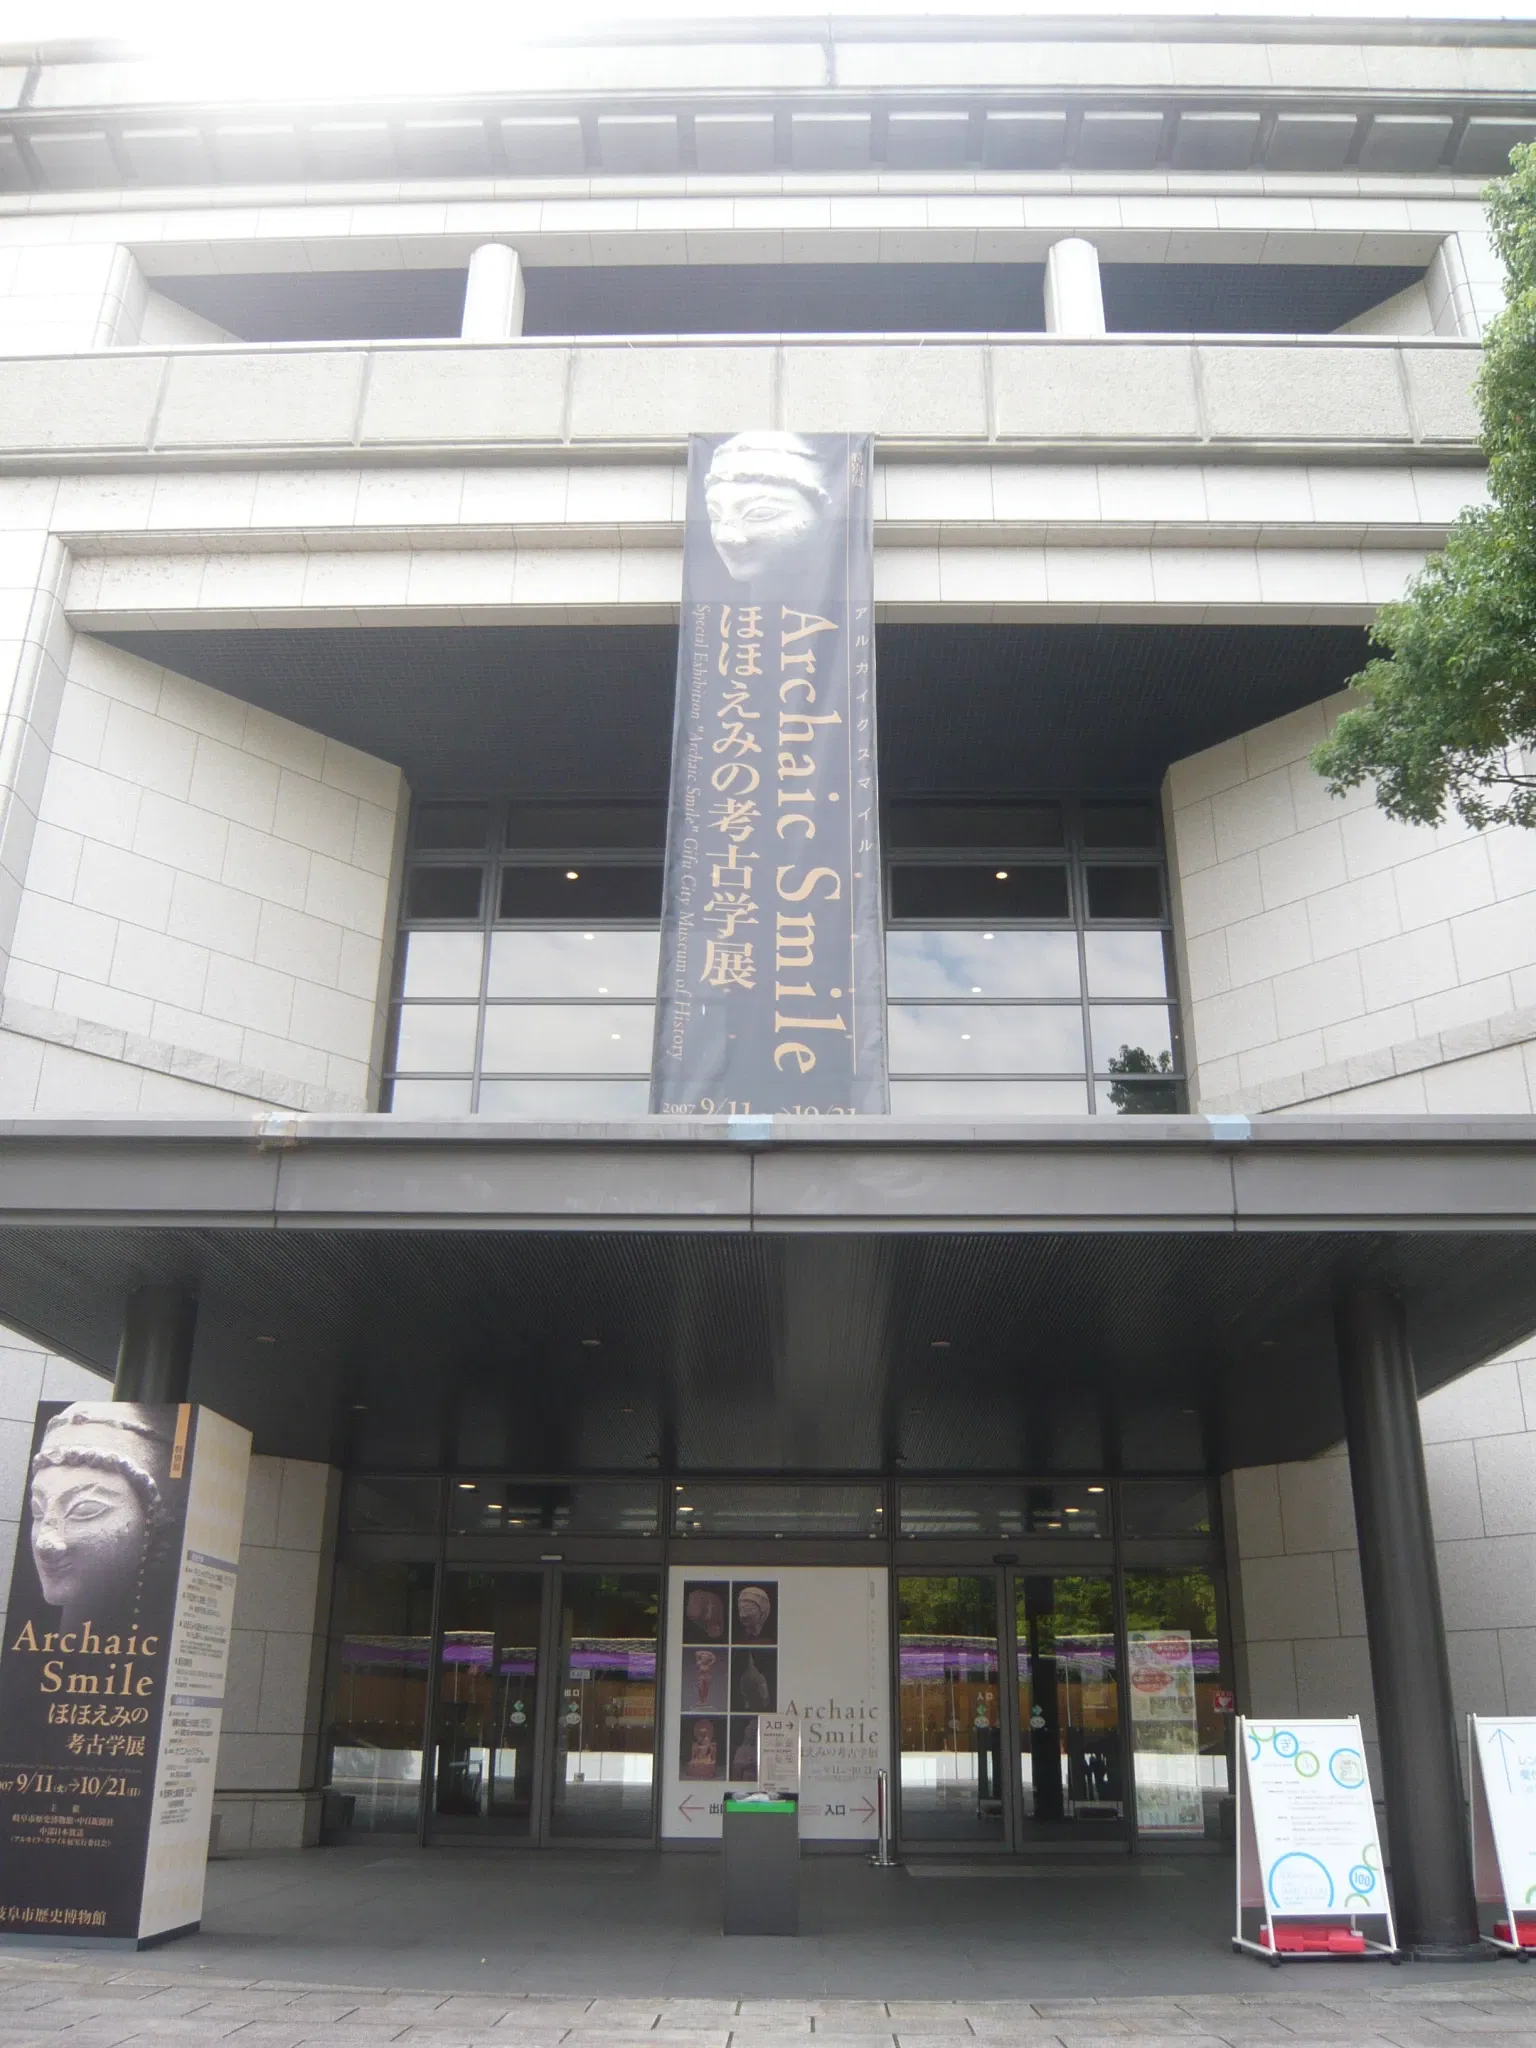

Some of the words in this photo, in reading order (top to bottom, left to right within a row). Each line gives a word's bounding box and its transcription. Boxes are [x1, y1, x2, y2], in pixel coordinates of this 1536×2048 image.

[692, 604, 710, 648] Special
[691, 652, 708, 719] Exhibition
[776, 605, 842, 839] Archaic
[699, 604, 764, 989] ほほえみの考古学展
[682, 837, 699, 869] Gifu
[679, 874, 697, 906] City
[675, 910, 695, 973] Museum
[773, 864, 847, 1073] Smile
[675, 979, 692, 998] of
[669, 1000, 691, 1061] History
[662, 1102, 696, 1115] 2007
[12, 1619, 159, 1656] Archaic
[40, 1660, 154, 1697] Smile
[48, 1703, 149, 1726] ほほえみの
[784, 1697, 880, 1720] Archaic
[766, 1720, 783, 1730] 入口
[808, 1722, 879, 1744] Smile
[66, 1735, 146, 1757] 考古学展
[709, 1804, 724, 1815] 出
[824, 1803, 846, 1816] 入口
